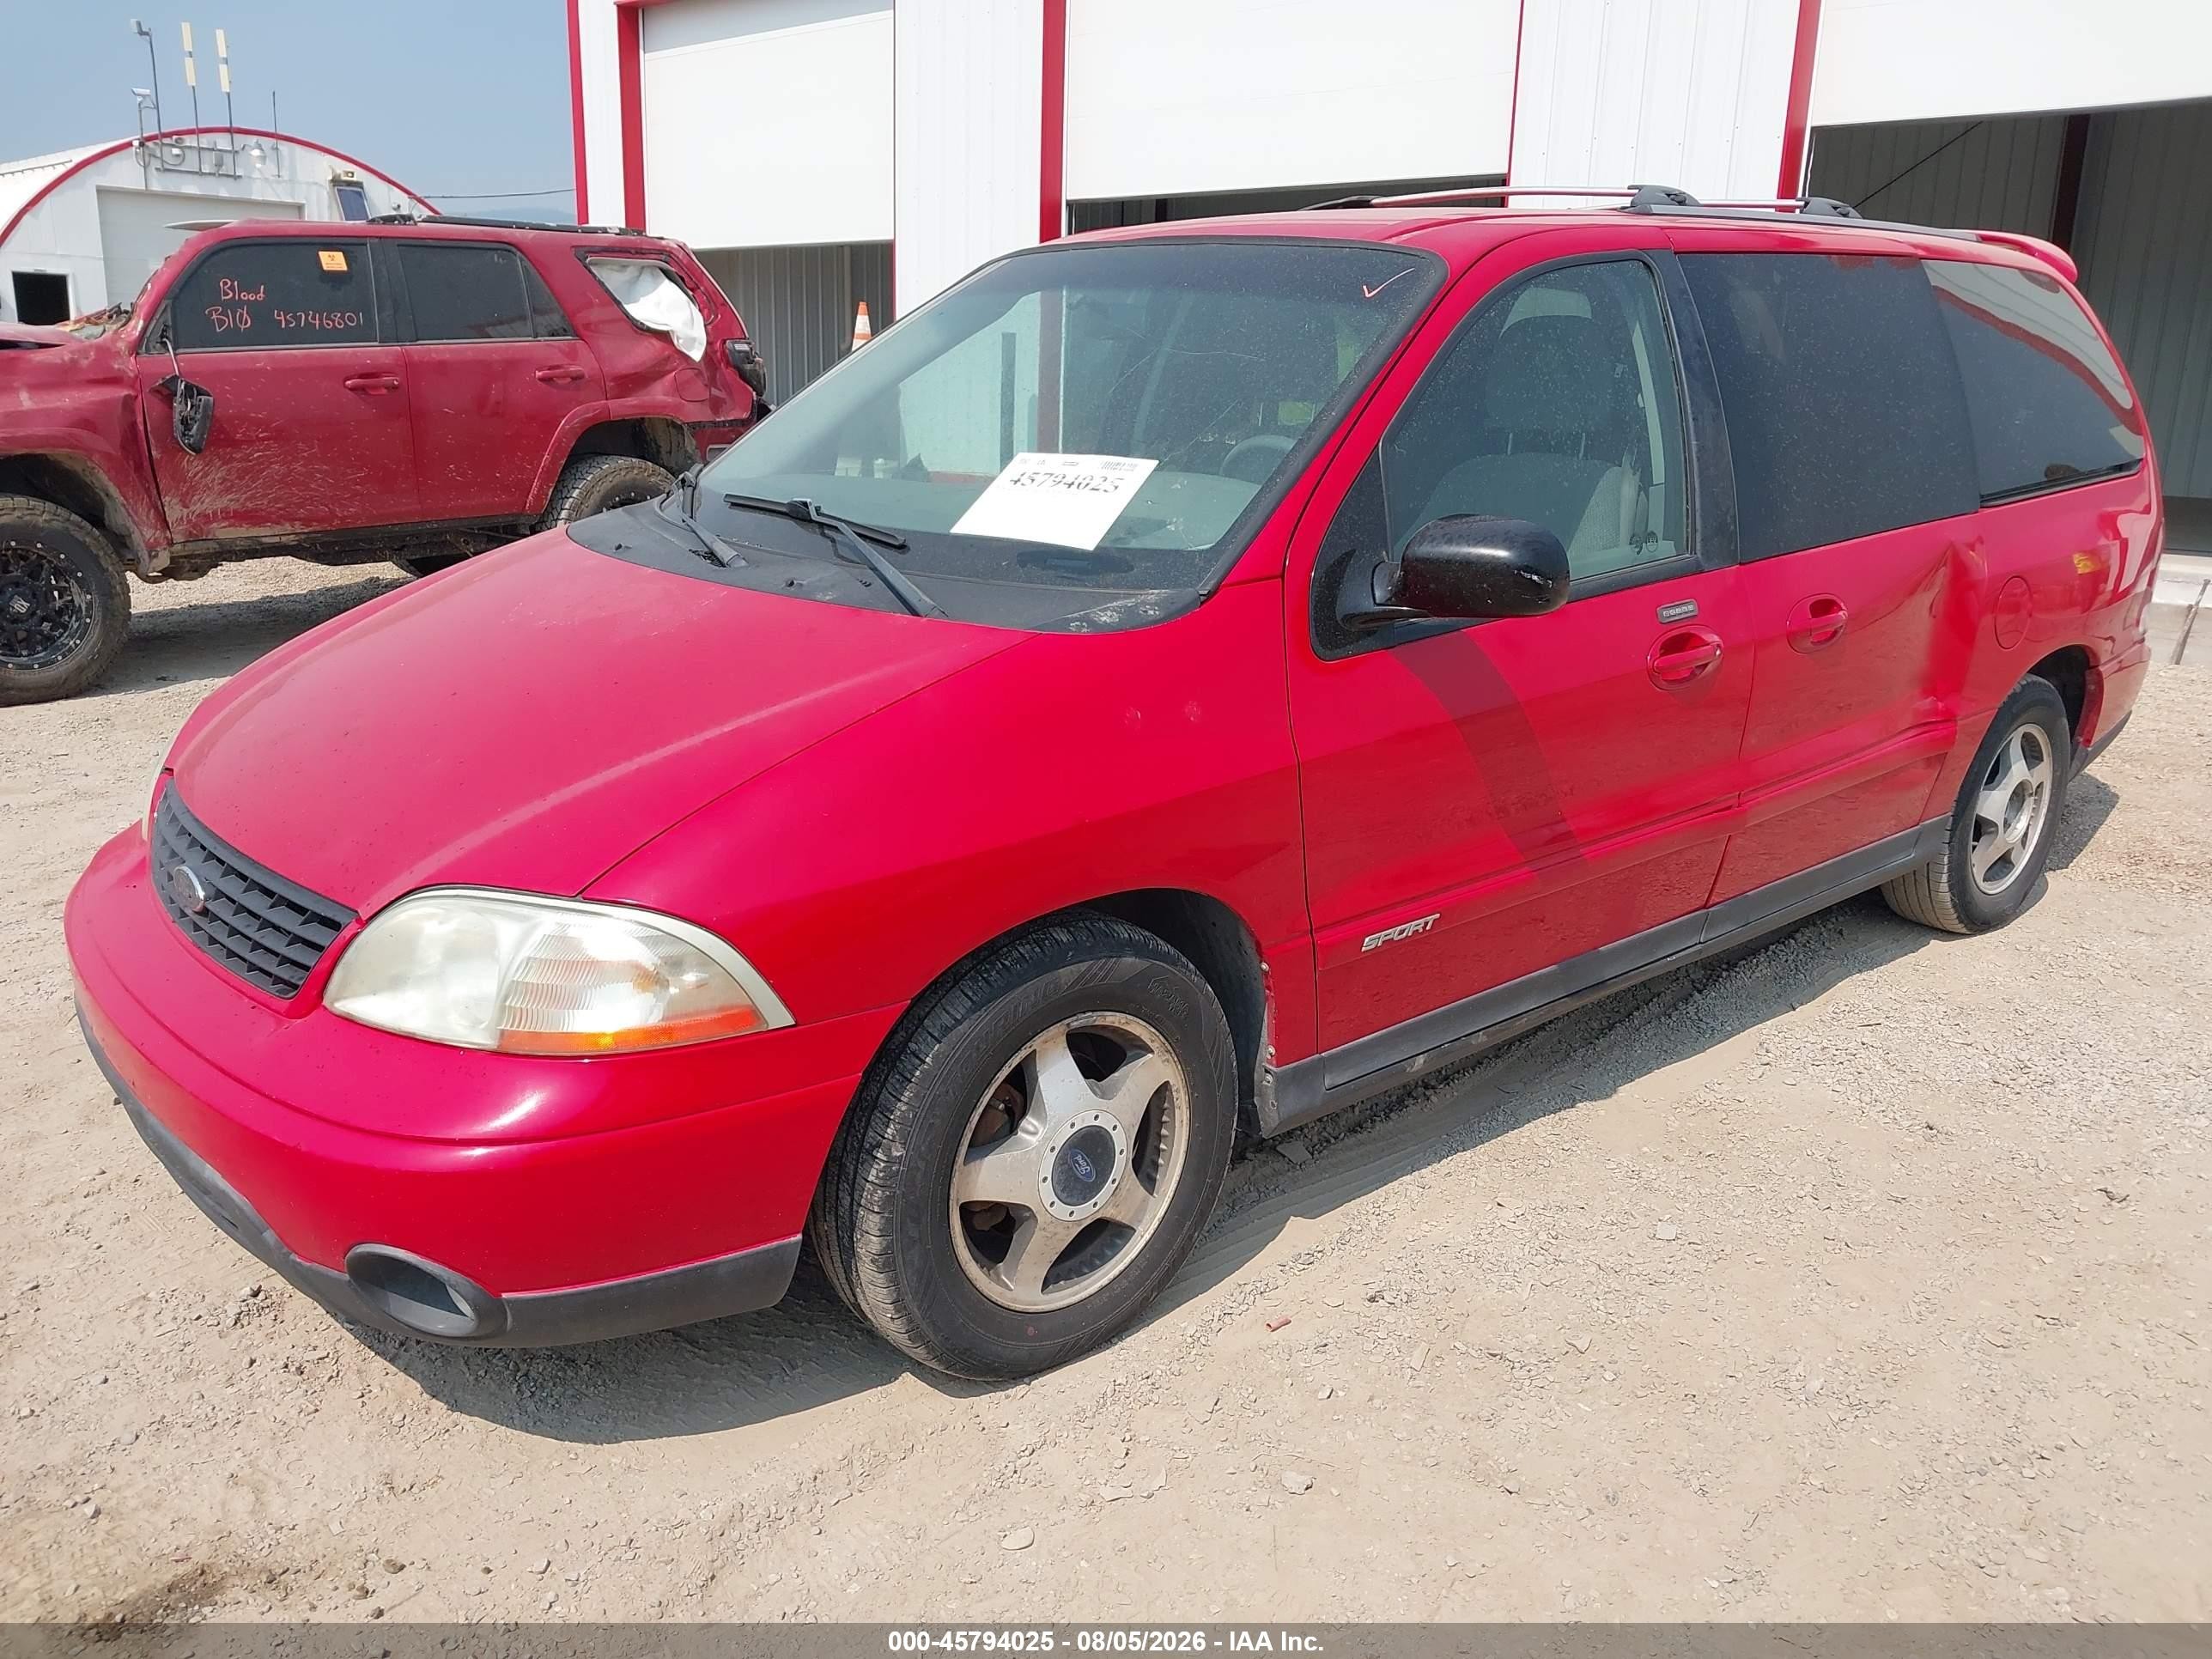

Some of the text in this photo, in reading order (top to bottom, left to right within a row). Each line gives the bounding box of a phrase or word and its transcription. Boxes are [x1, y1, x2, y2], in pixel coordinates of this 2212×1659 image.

[219, 278, 266, 301] Blood
[274, 309, 363, 329] 45746801
[1010, 471, 1124, 493] 45794025
[1361, 913, 1441, 952] SPORT
